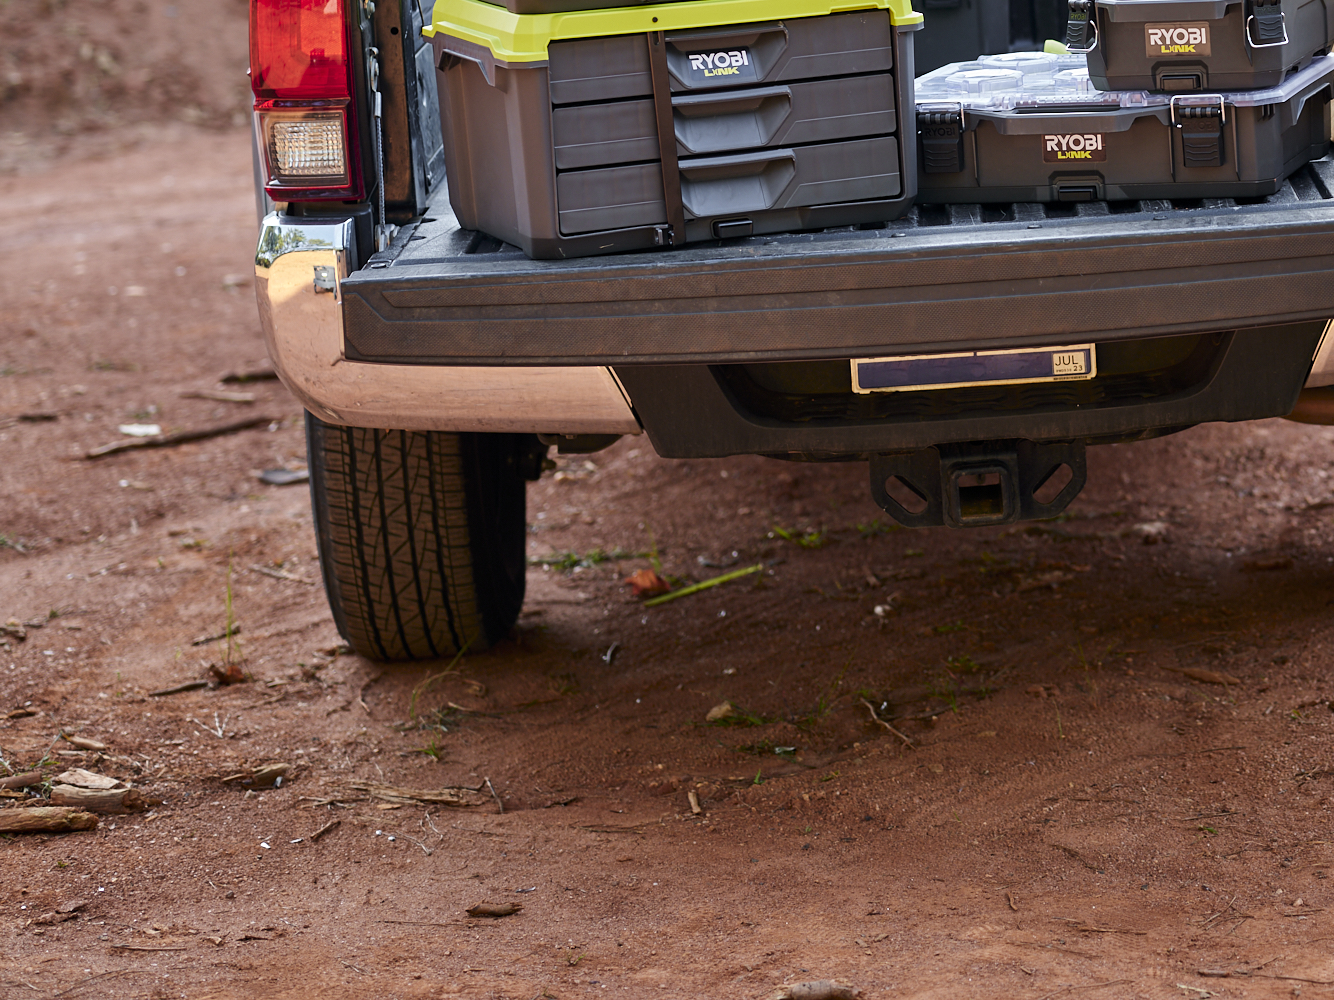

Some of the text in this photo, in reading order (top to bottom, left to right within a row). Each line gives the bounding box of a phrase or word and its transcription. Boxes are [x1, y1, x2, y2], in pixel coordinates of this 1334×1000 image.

[1148, 27, 1206, 45] RYOBI
[688, 50, 749, 70] RYOBI
[924, 127, 956, 137] RYOBI
[1044, 134, 1103, 151] RYOBI
[1055, 355, 1078, 366] JUL
